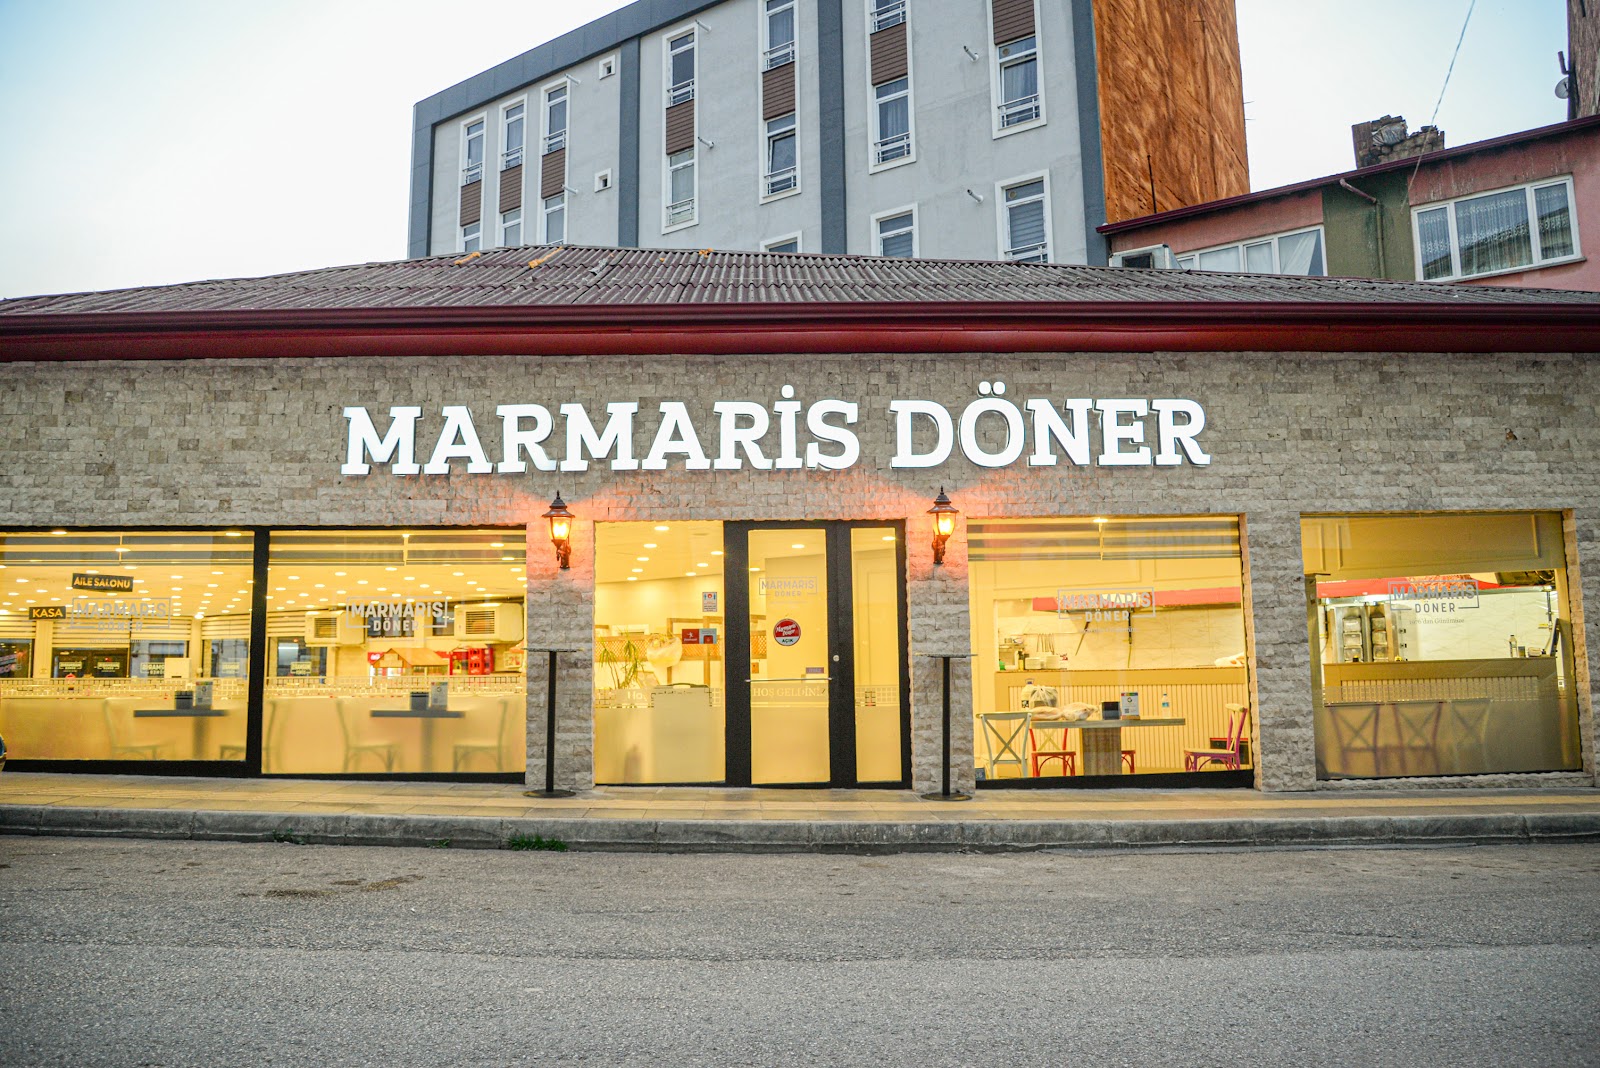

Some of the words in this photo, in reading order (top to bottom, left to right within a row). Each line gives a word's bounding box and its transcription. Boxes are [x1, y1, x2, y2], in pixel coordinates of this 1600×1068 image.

[340, 385, 860, 476] MARMARİS
[889, 381, 1211, 469] DÖNER
[94, 578, 131, 588] SALONU
[32, 608, 63, 618] KASA
[1415, 601, 1455, 613] DÖNER
[1085, 609, 1130, 622] DÖNER
[373, 618, 419, 631] DÖNER
